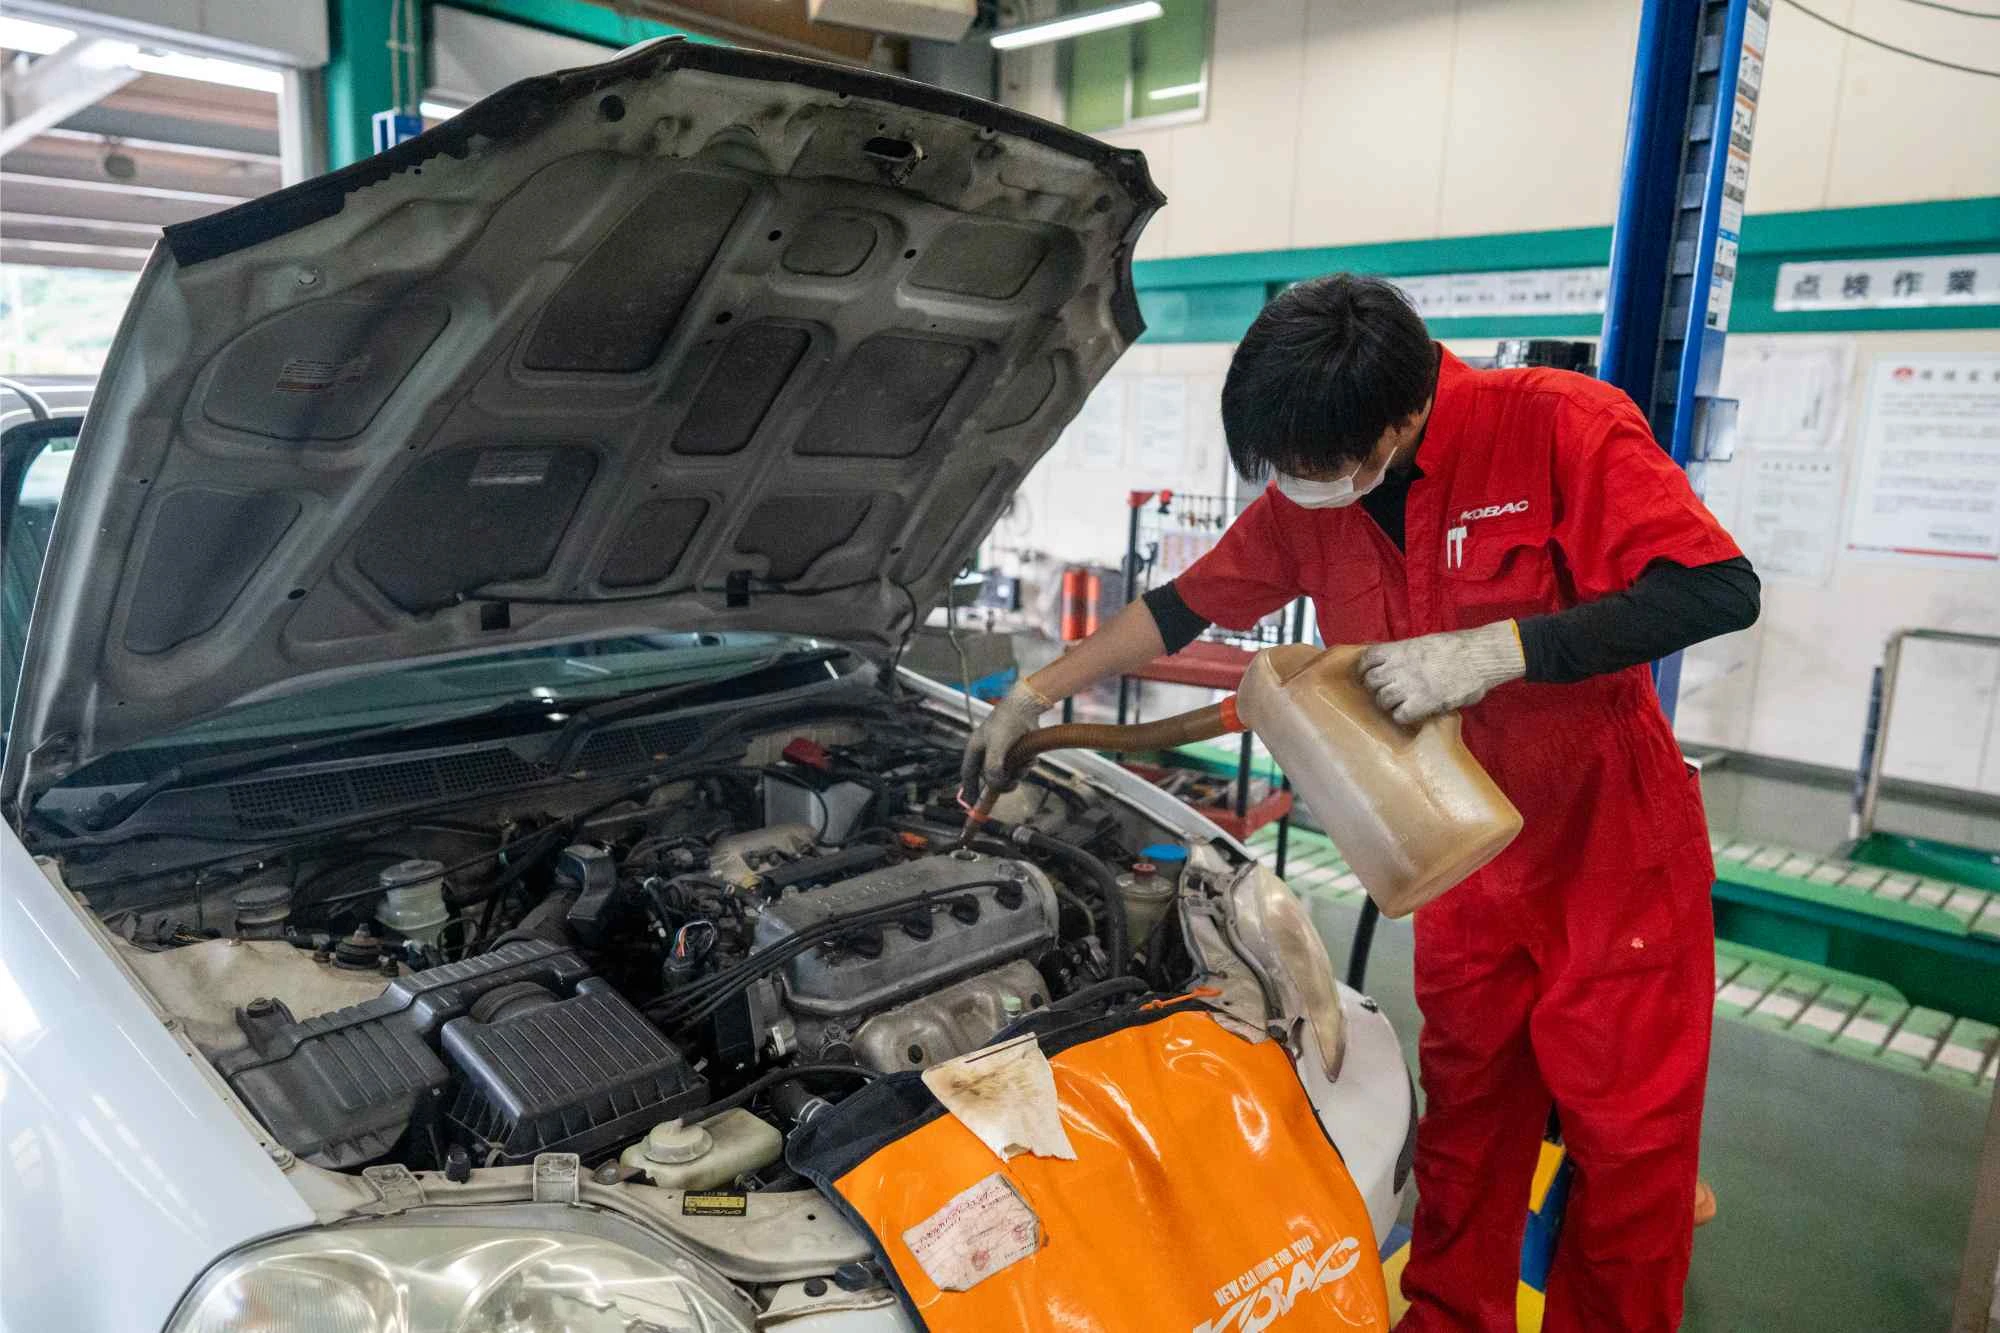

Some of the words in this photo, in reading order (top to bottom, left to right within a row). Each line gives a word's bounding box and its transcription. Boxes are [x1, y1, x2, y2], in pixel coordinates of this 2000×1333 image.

[1460, 500, 1529, 521] KOBAC
[1213, 1280, 1241, 1307] NEW
[1290, 1235, 1314, 1257] YOU
